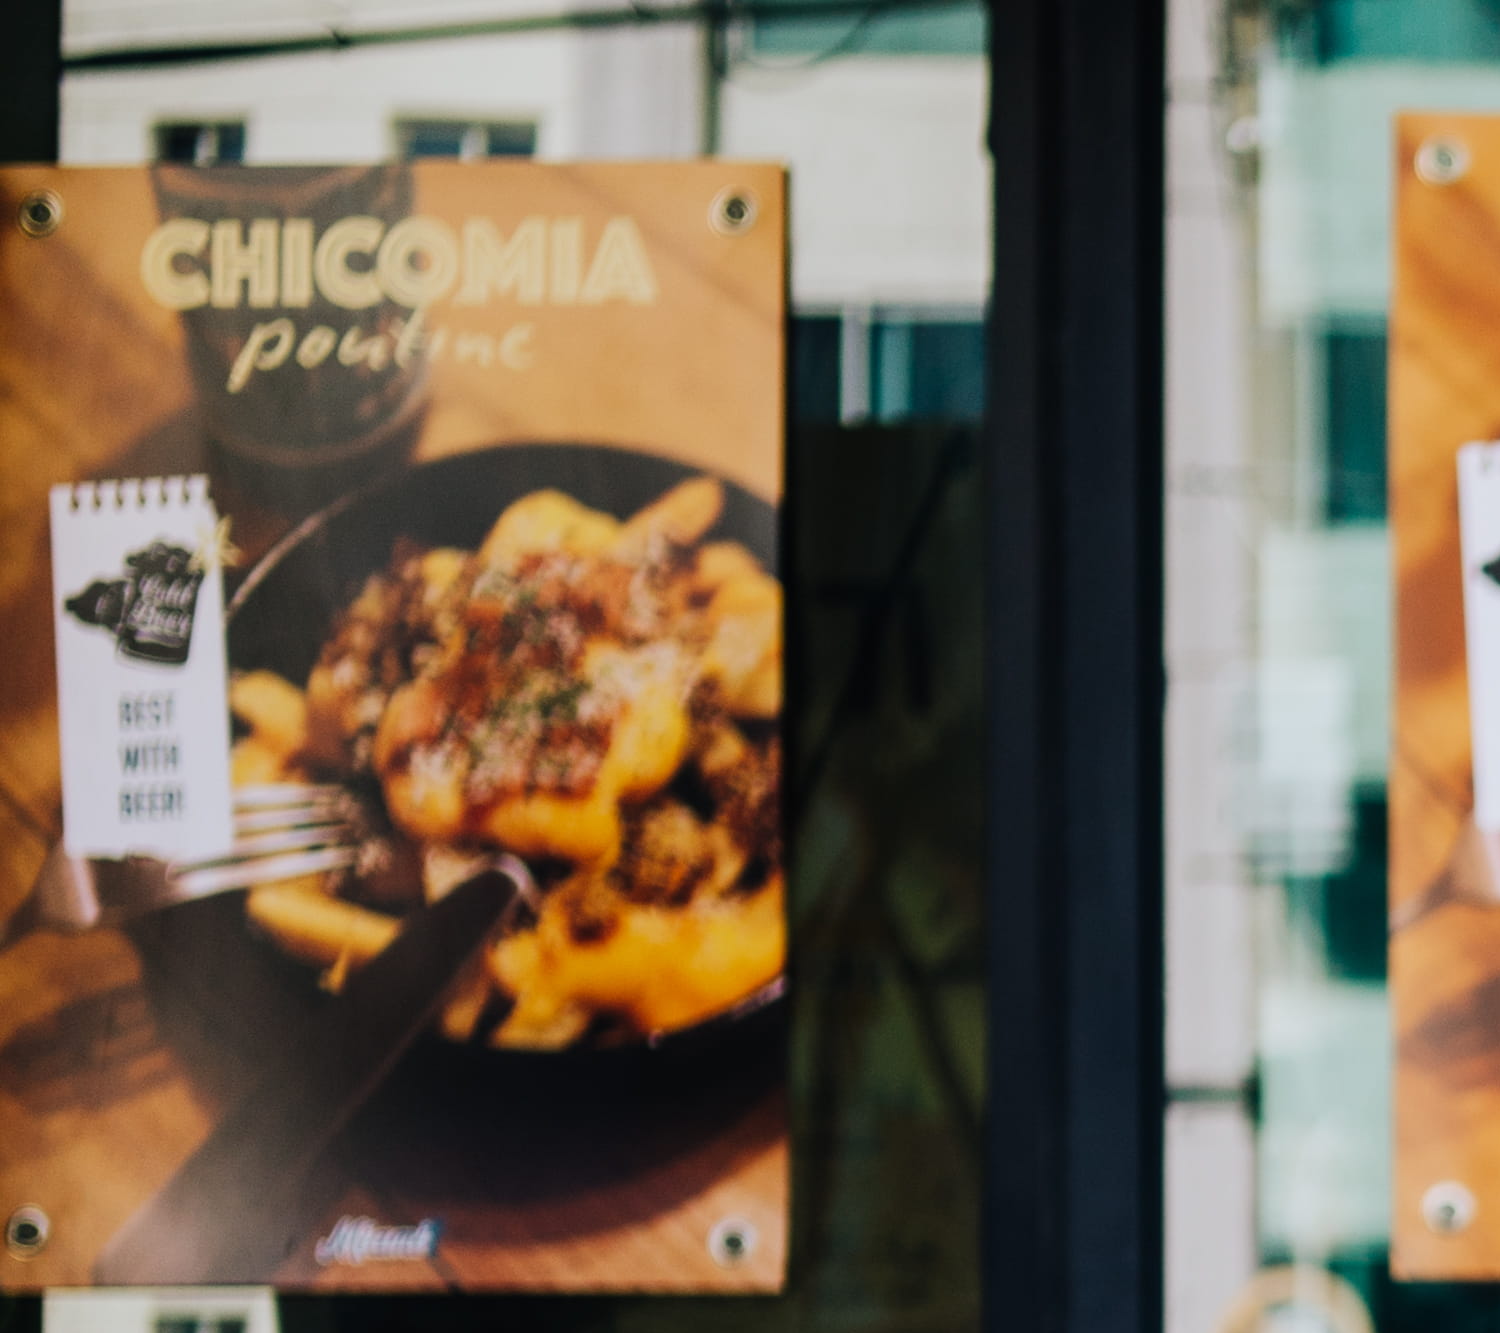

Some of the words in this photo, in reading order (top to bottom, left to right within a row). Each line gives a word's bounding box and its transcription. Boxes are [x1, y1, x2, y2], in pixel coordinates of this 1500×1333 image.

[140, 216, 657, 310] CHICOMIA
[226, 304, 536, 395] poutine
[119, 692, 174, 727] BEST
[120, 738, 181, 773] WITH
